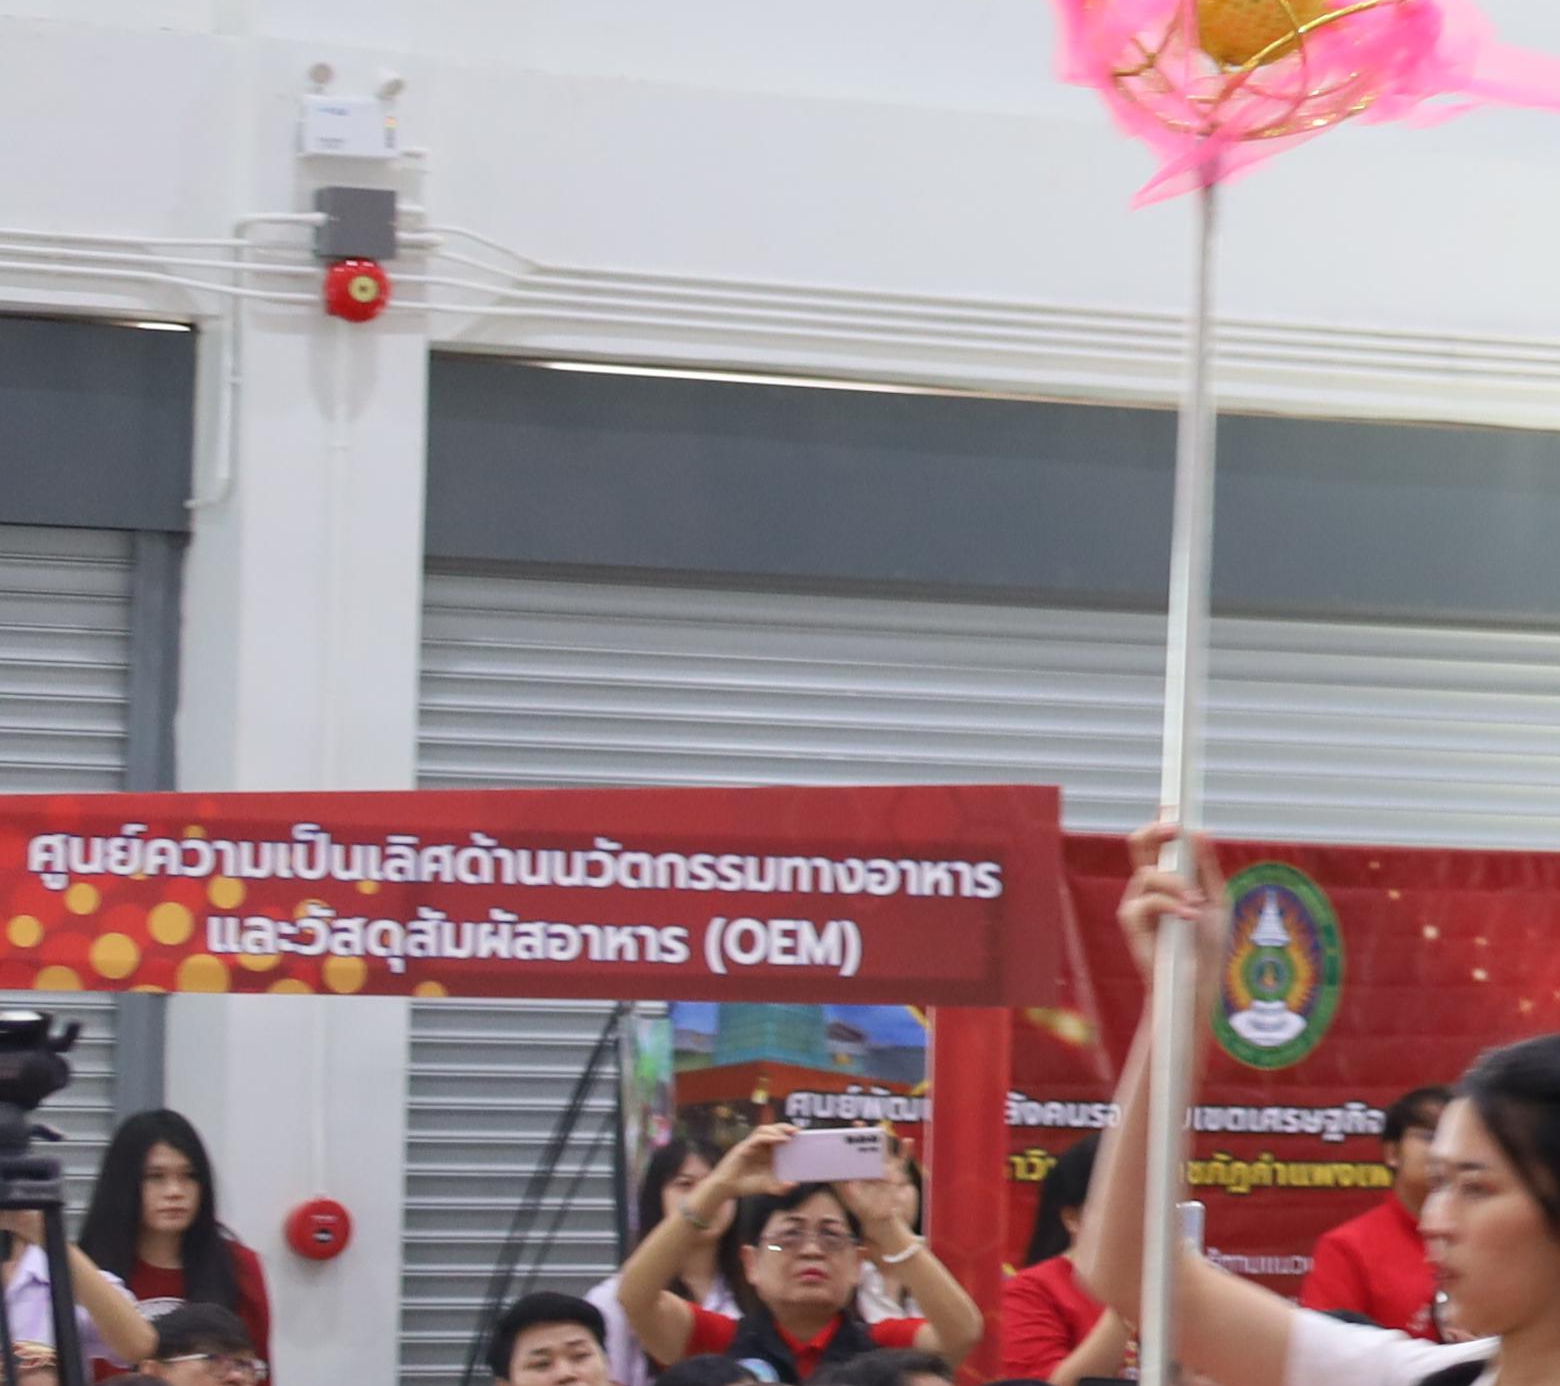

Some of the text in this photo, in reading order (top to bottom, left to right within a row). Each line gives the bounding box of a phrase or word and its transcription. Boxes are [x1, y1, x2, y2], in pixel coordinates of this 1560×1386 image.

[27, 822, 1004, 898] ศูนย์ความเป็นเลิศด้านนวัตกรรมทางอาหาร
[206, 904, 863, 977] และวัสดุสัมผัสอาหาร (OEM)
